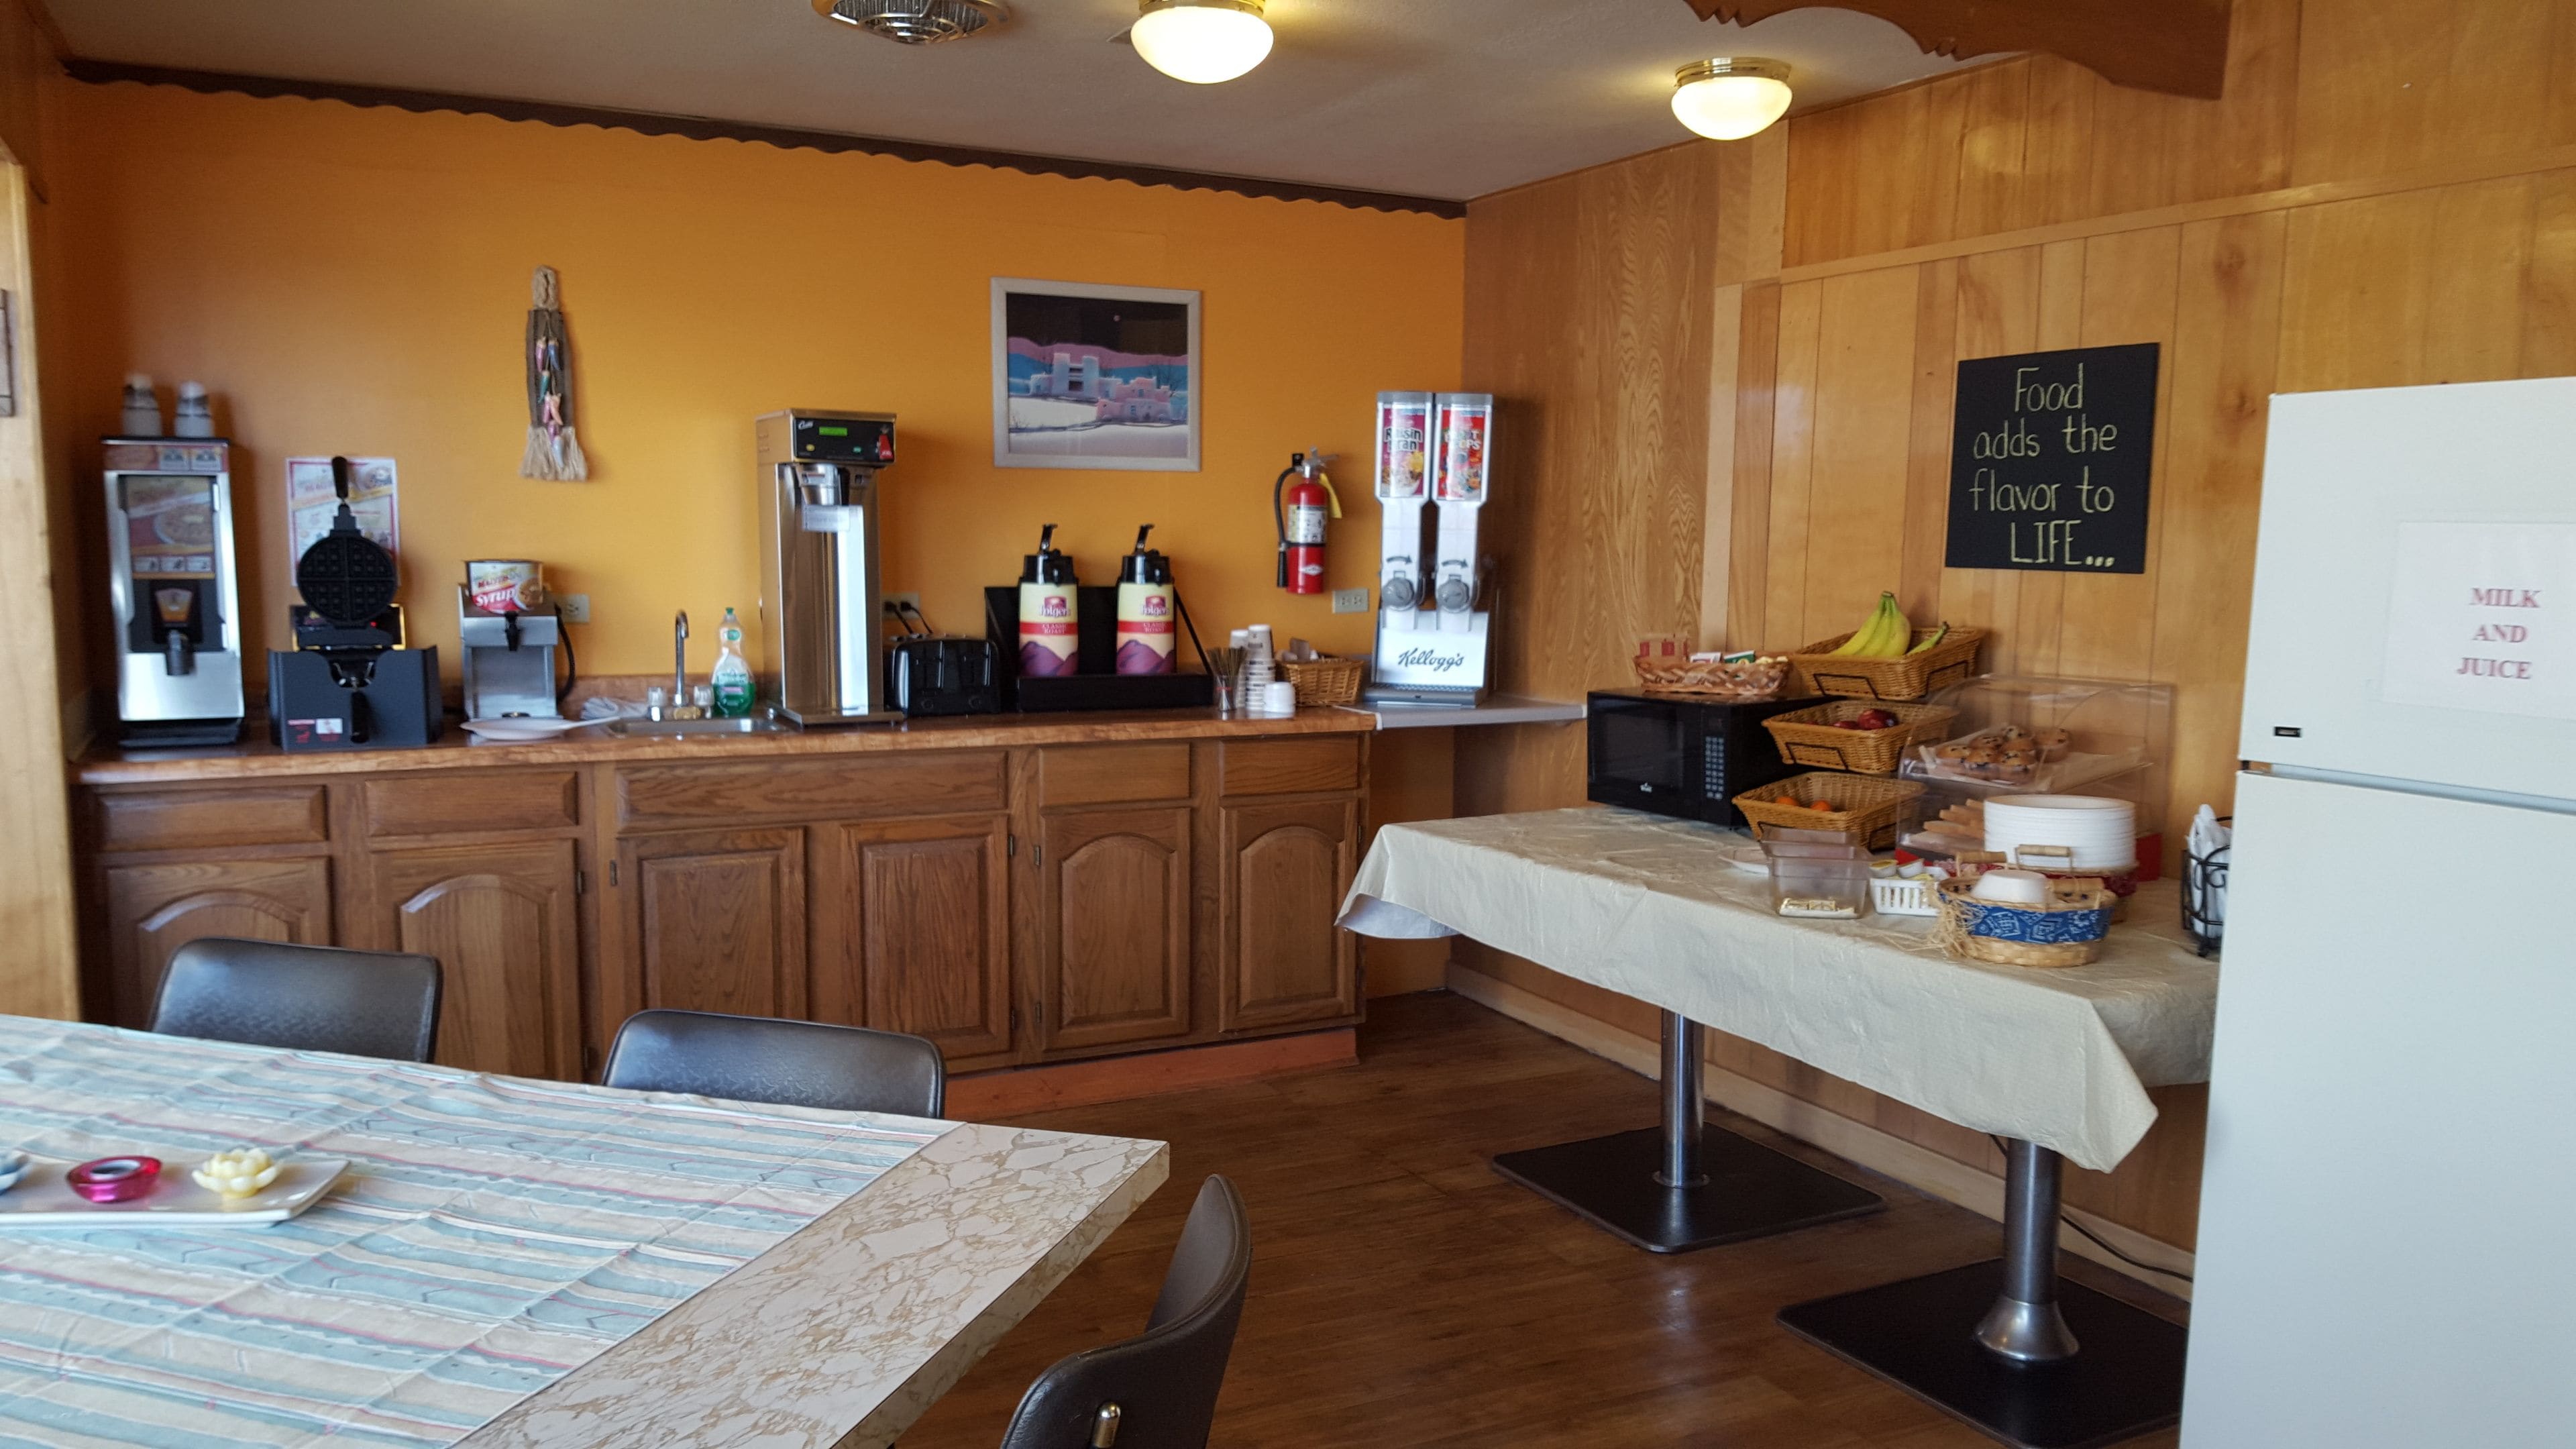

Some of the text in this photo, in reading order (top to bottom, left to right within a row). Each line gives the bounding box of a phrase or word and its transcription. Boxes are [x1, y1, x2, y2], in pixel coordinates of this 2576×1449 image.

[2015, 363, 2083, 413] Food
[1389, 439, 1417, 451] ran
[1974, 413, 2118, 460] adds the
[1969, 466, 2115, 513] flavor to
[2469, 588, 2542, 608] MILK
[2472, 625, 2528, 643] AND
[1398, 647, 1464, 672] Kellogg's
[2457, 657, 2532, 679] JUICE
